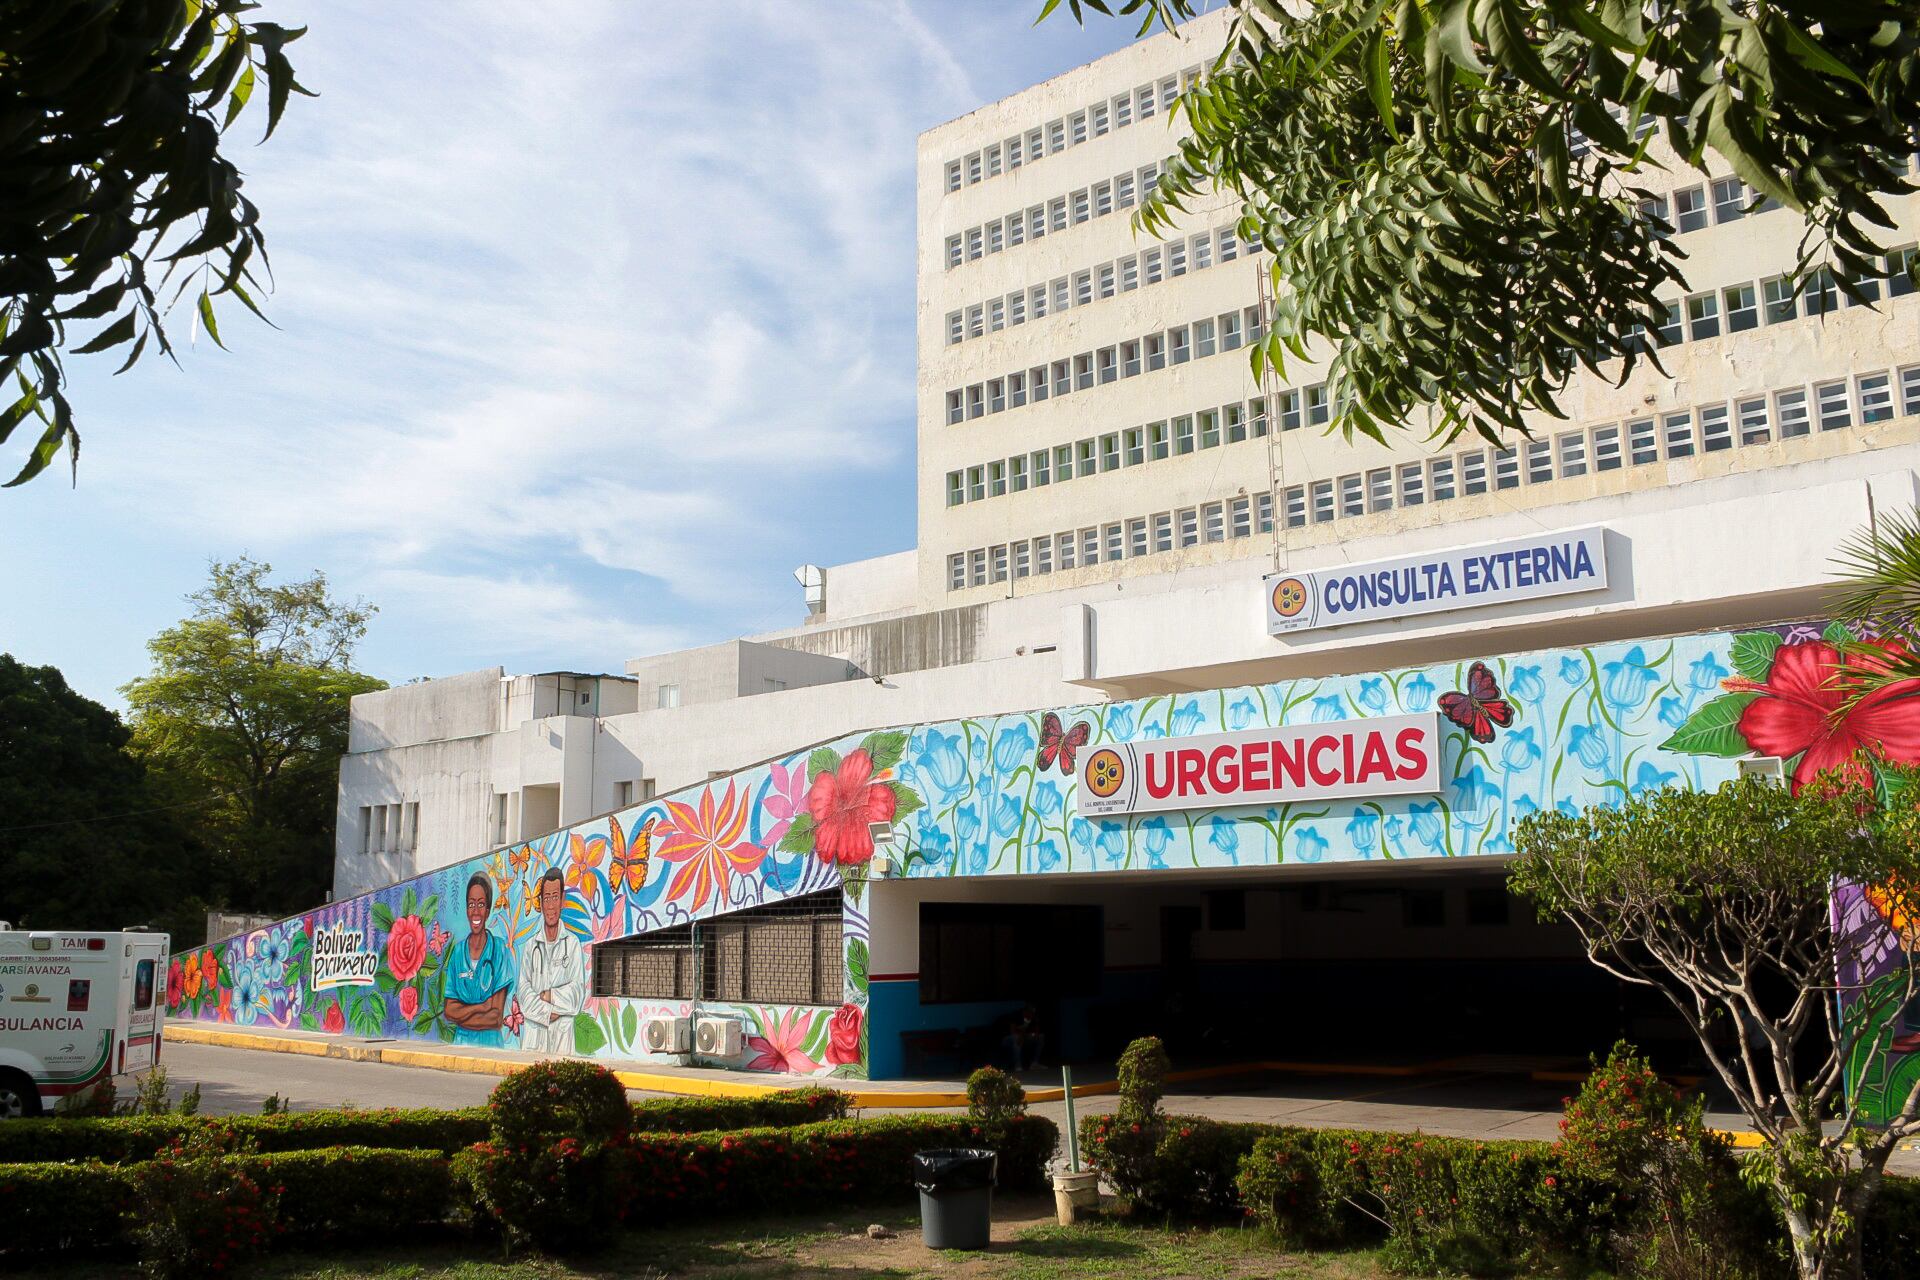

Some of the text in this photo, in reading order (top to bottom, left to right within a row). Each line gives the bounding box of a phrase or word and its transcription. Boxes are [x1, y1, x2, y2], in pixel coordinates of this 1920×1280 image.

[1324, 540, 1596, 614] CONSULTA EXTERNA
[1145, 727, 1428, 800] URGENCIAS
[61, 938, 86, 948] TAM
[316, 922, 361, 955] Bolívar
[314, 953, 377, 989] primero
